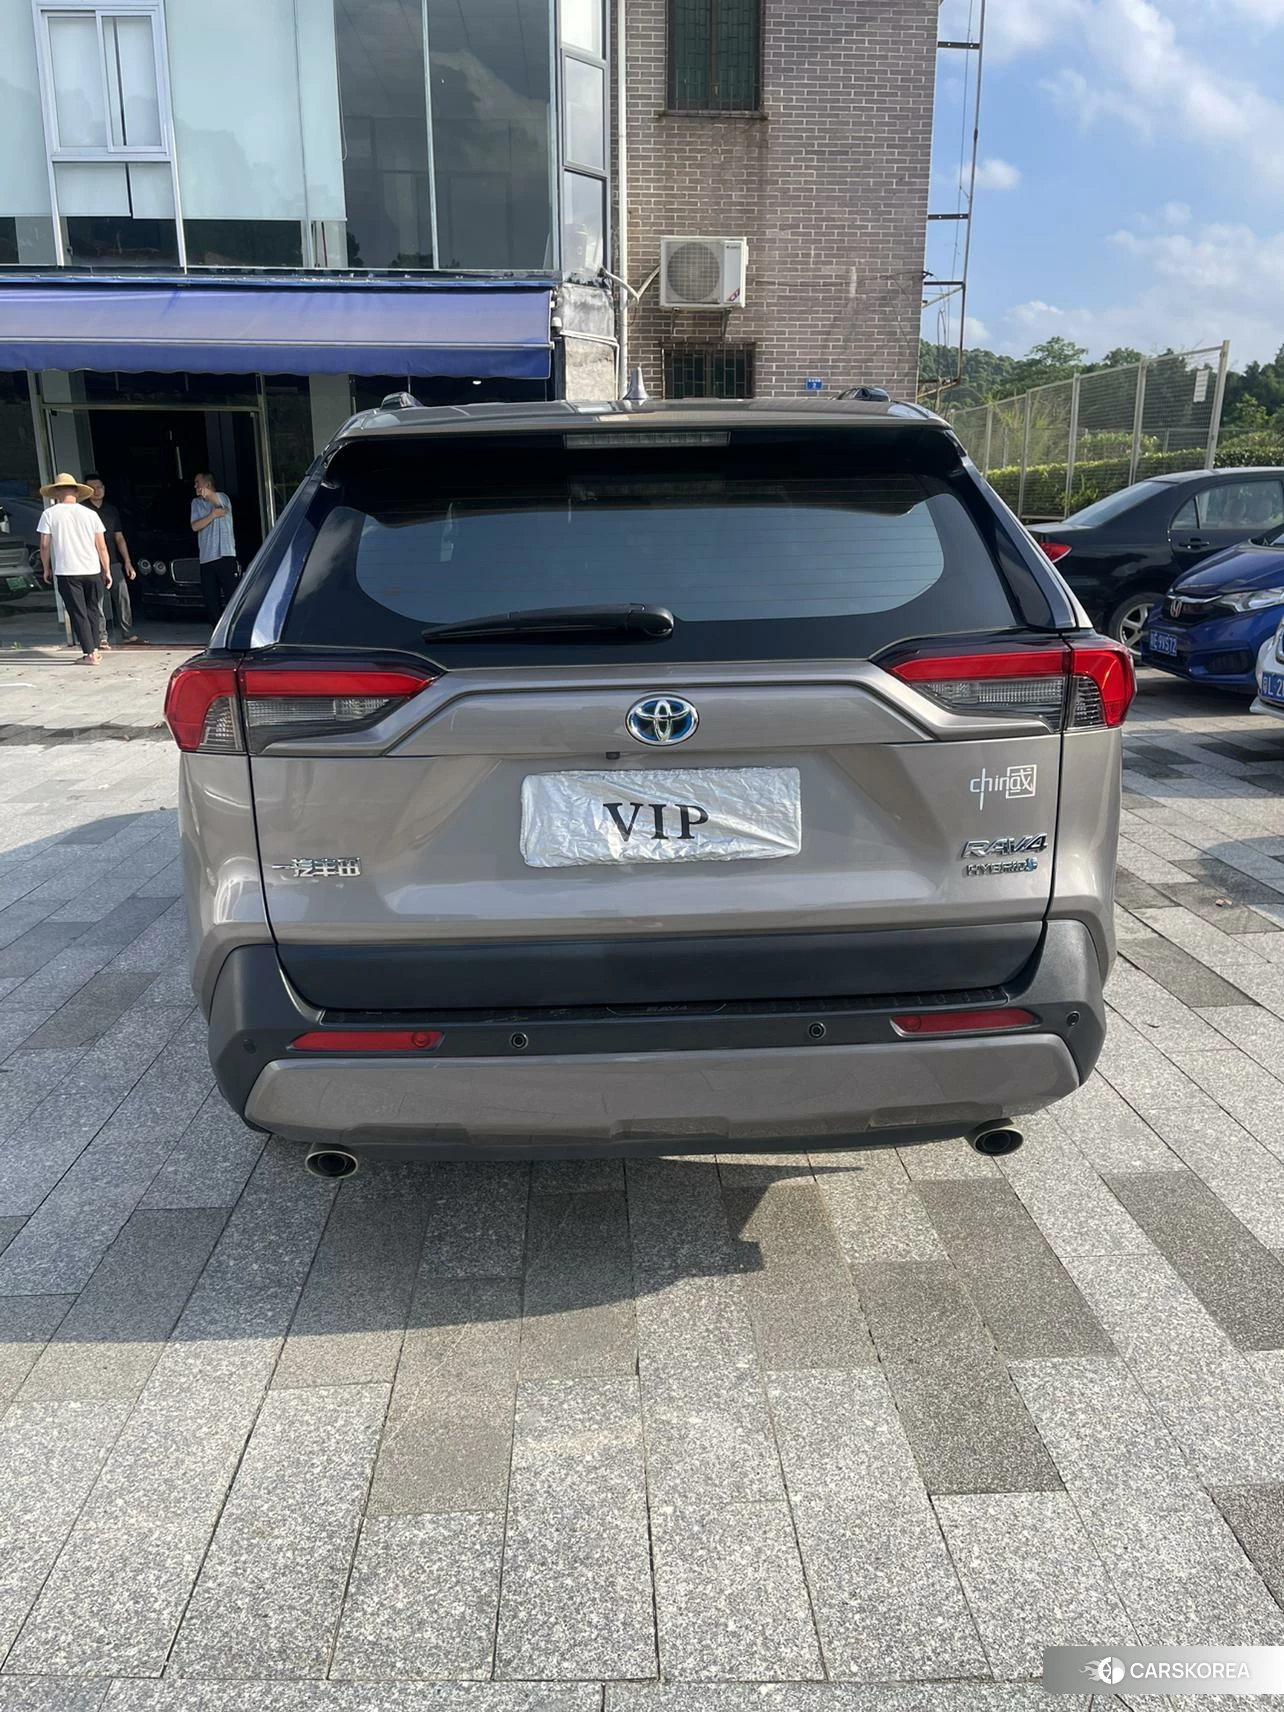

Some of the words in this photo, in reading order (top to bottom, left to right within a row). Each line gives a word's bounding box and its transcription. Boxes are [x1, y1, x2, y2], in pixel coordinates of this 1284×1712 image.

[603, 802, 709, 842] VIP
[961, 832, 1048, 858] RAV4
[272, 857, 361, 877] 一汽丰田
[965, 860, 1028, 876] HYBRID
